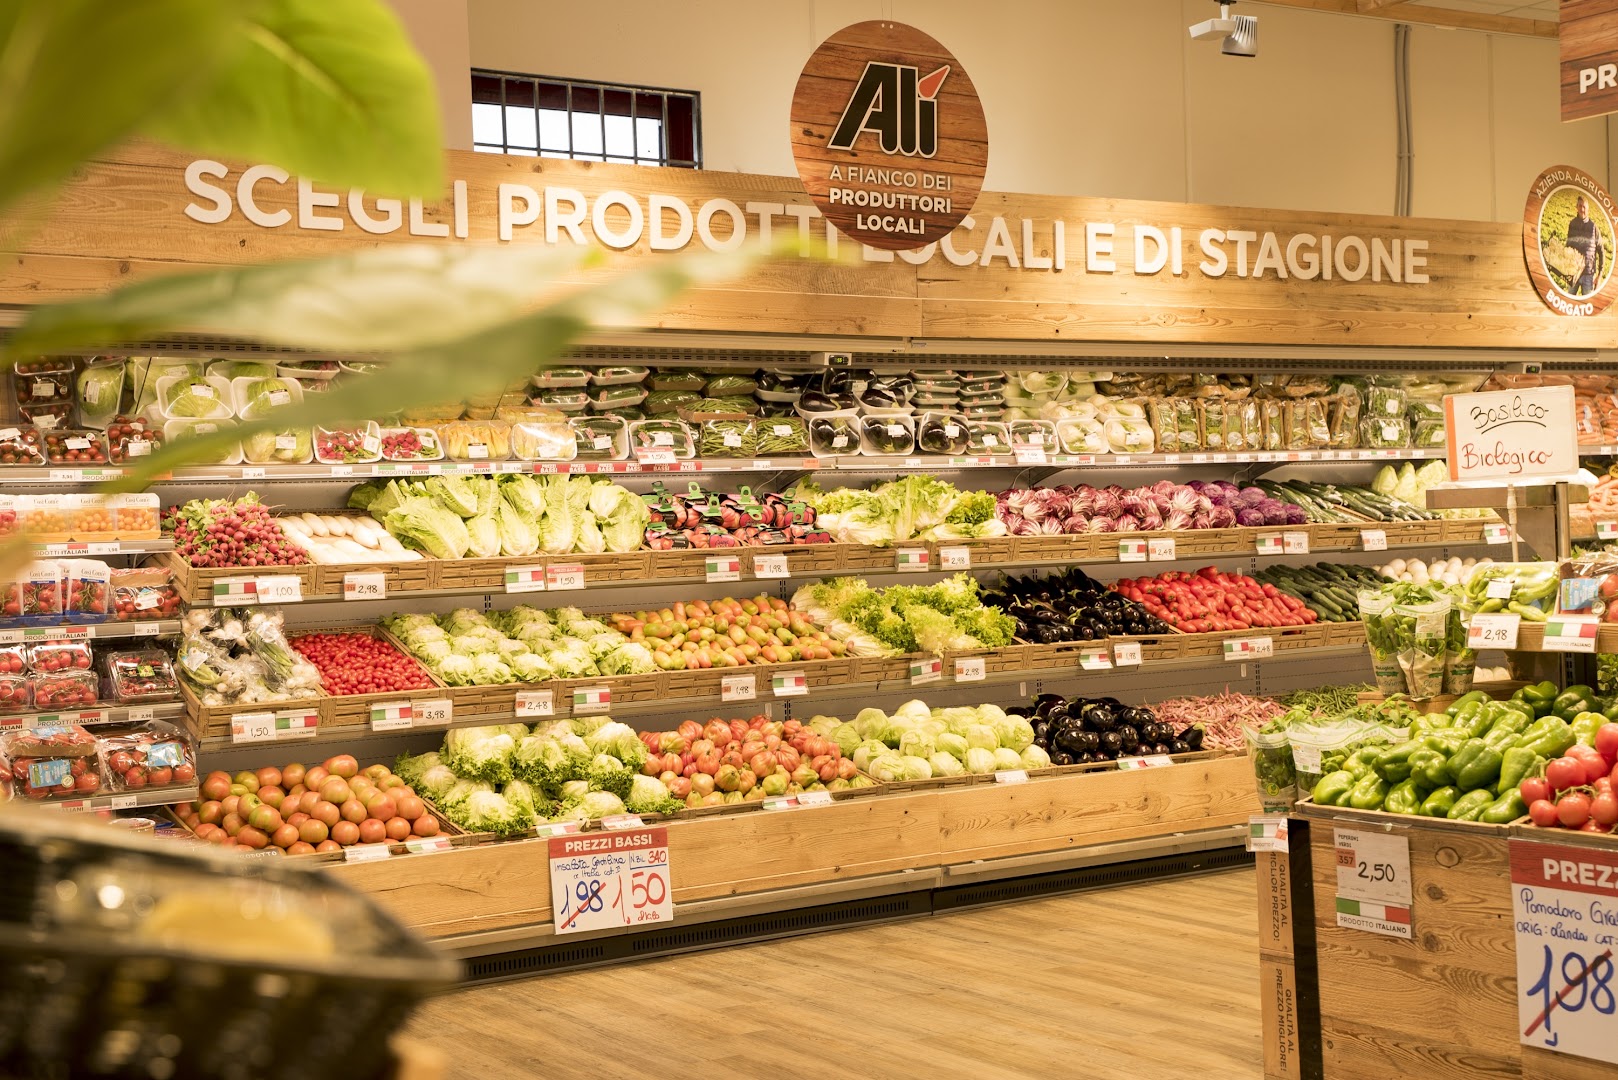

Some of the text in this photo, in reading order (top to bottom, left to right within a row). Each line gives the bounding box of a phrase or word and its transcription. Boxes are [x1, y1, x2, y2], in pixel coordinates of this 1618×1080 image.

[829, 165, 951, 191] A FIANCO DEI
[1535, 170, 1573, 199] AZIENDA
[829, 188, 951, 214] PRODUTTORI
[184, 159, 1430, 284] SCEGLI PRODOTTI CALI E DI STAGIONE
[856, 214, 925, 235] LOCALI
[1545, 288, 1594, 316] BORGATO
[1461, 441, 1553, 474] Biologico
[768, 564, 782, 573] 1,98
[276, 586, 293, 597] 1,00
[357, 584, 378, 594] 2,98
[1484, 629, 1508, 641] 2,98
[736, 686, 749, 694] 1,98
[426, 710, 445, 720] 3,98
[527, 701, 548, 710] 2,48
[250, 726, 269, 738] 1,50
[565, 834, 652, 853] PREZZI BASSI
[648, 850, 667, 864] 340
[1338, 855, 1354, 865] 357
[1358, 861, 1395, 882] 2,50
[1543, 858, 1618, 891] PREZ
[1279, 864, 1288, 928] QUALITÀ AL
[1520, 888, 1618, 926] Pomodoro Gra
[1272, 895, 1280, 942] PREZZO!
[1340, 916, 1406, 934] PRODOTTO ITALIANO
[1276, 968, 1287, 1072] PREZZO MIGLIORE!
[1285, 988, 1294, 1054] QUALITÀ AL
